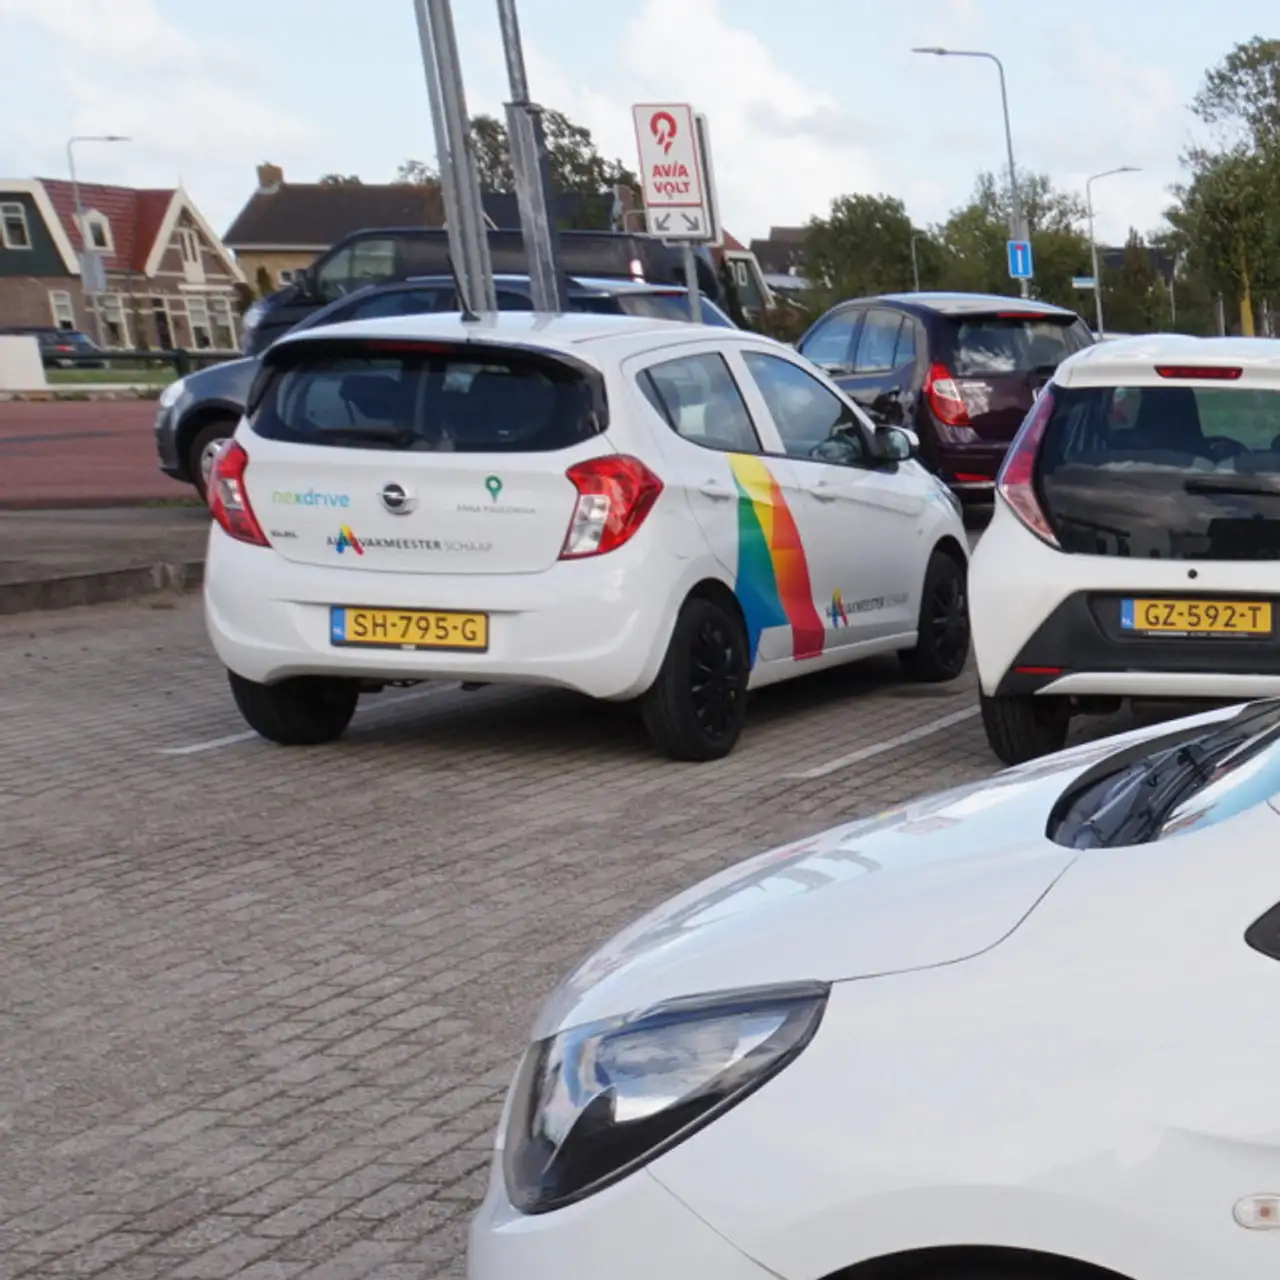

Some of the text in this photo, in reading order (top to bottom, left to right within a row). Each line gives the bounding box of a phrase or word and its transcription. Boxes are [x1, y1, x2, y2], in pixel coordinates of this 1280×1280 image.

[651, 162, 690, 178] AVIA
[653, 181, 690, 195] VOLT
[272, 489, 350, 508] nexdrive
[326, 535, 442, 551] AVAKMEESTER
[1144, 603, 1262, 628] GZ-592-T
[353, 613, 478, 641] SH-795-G
